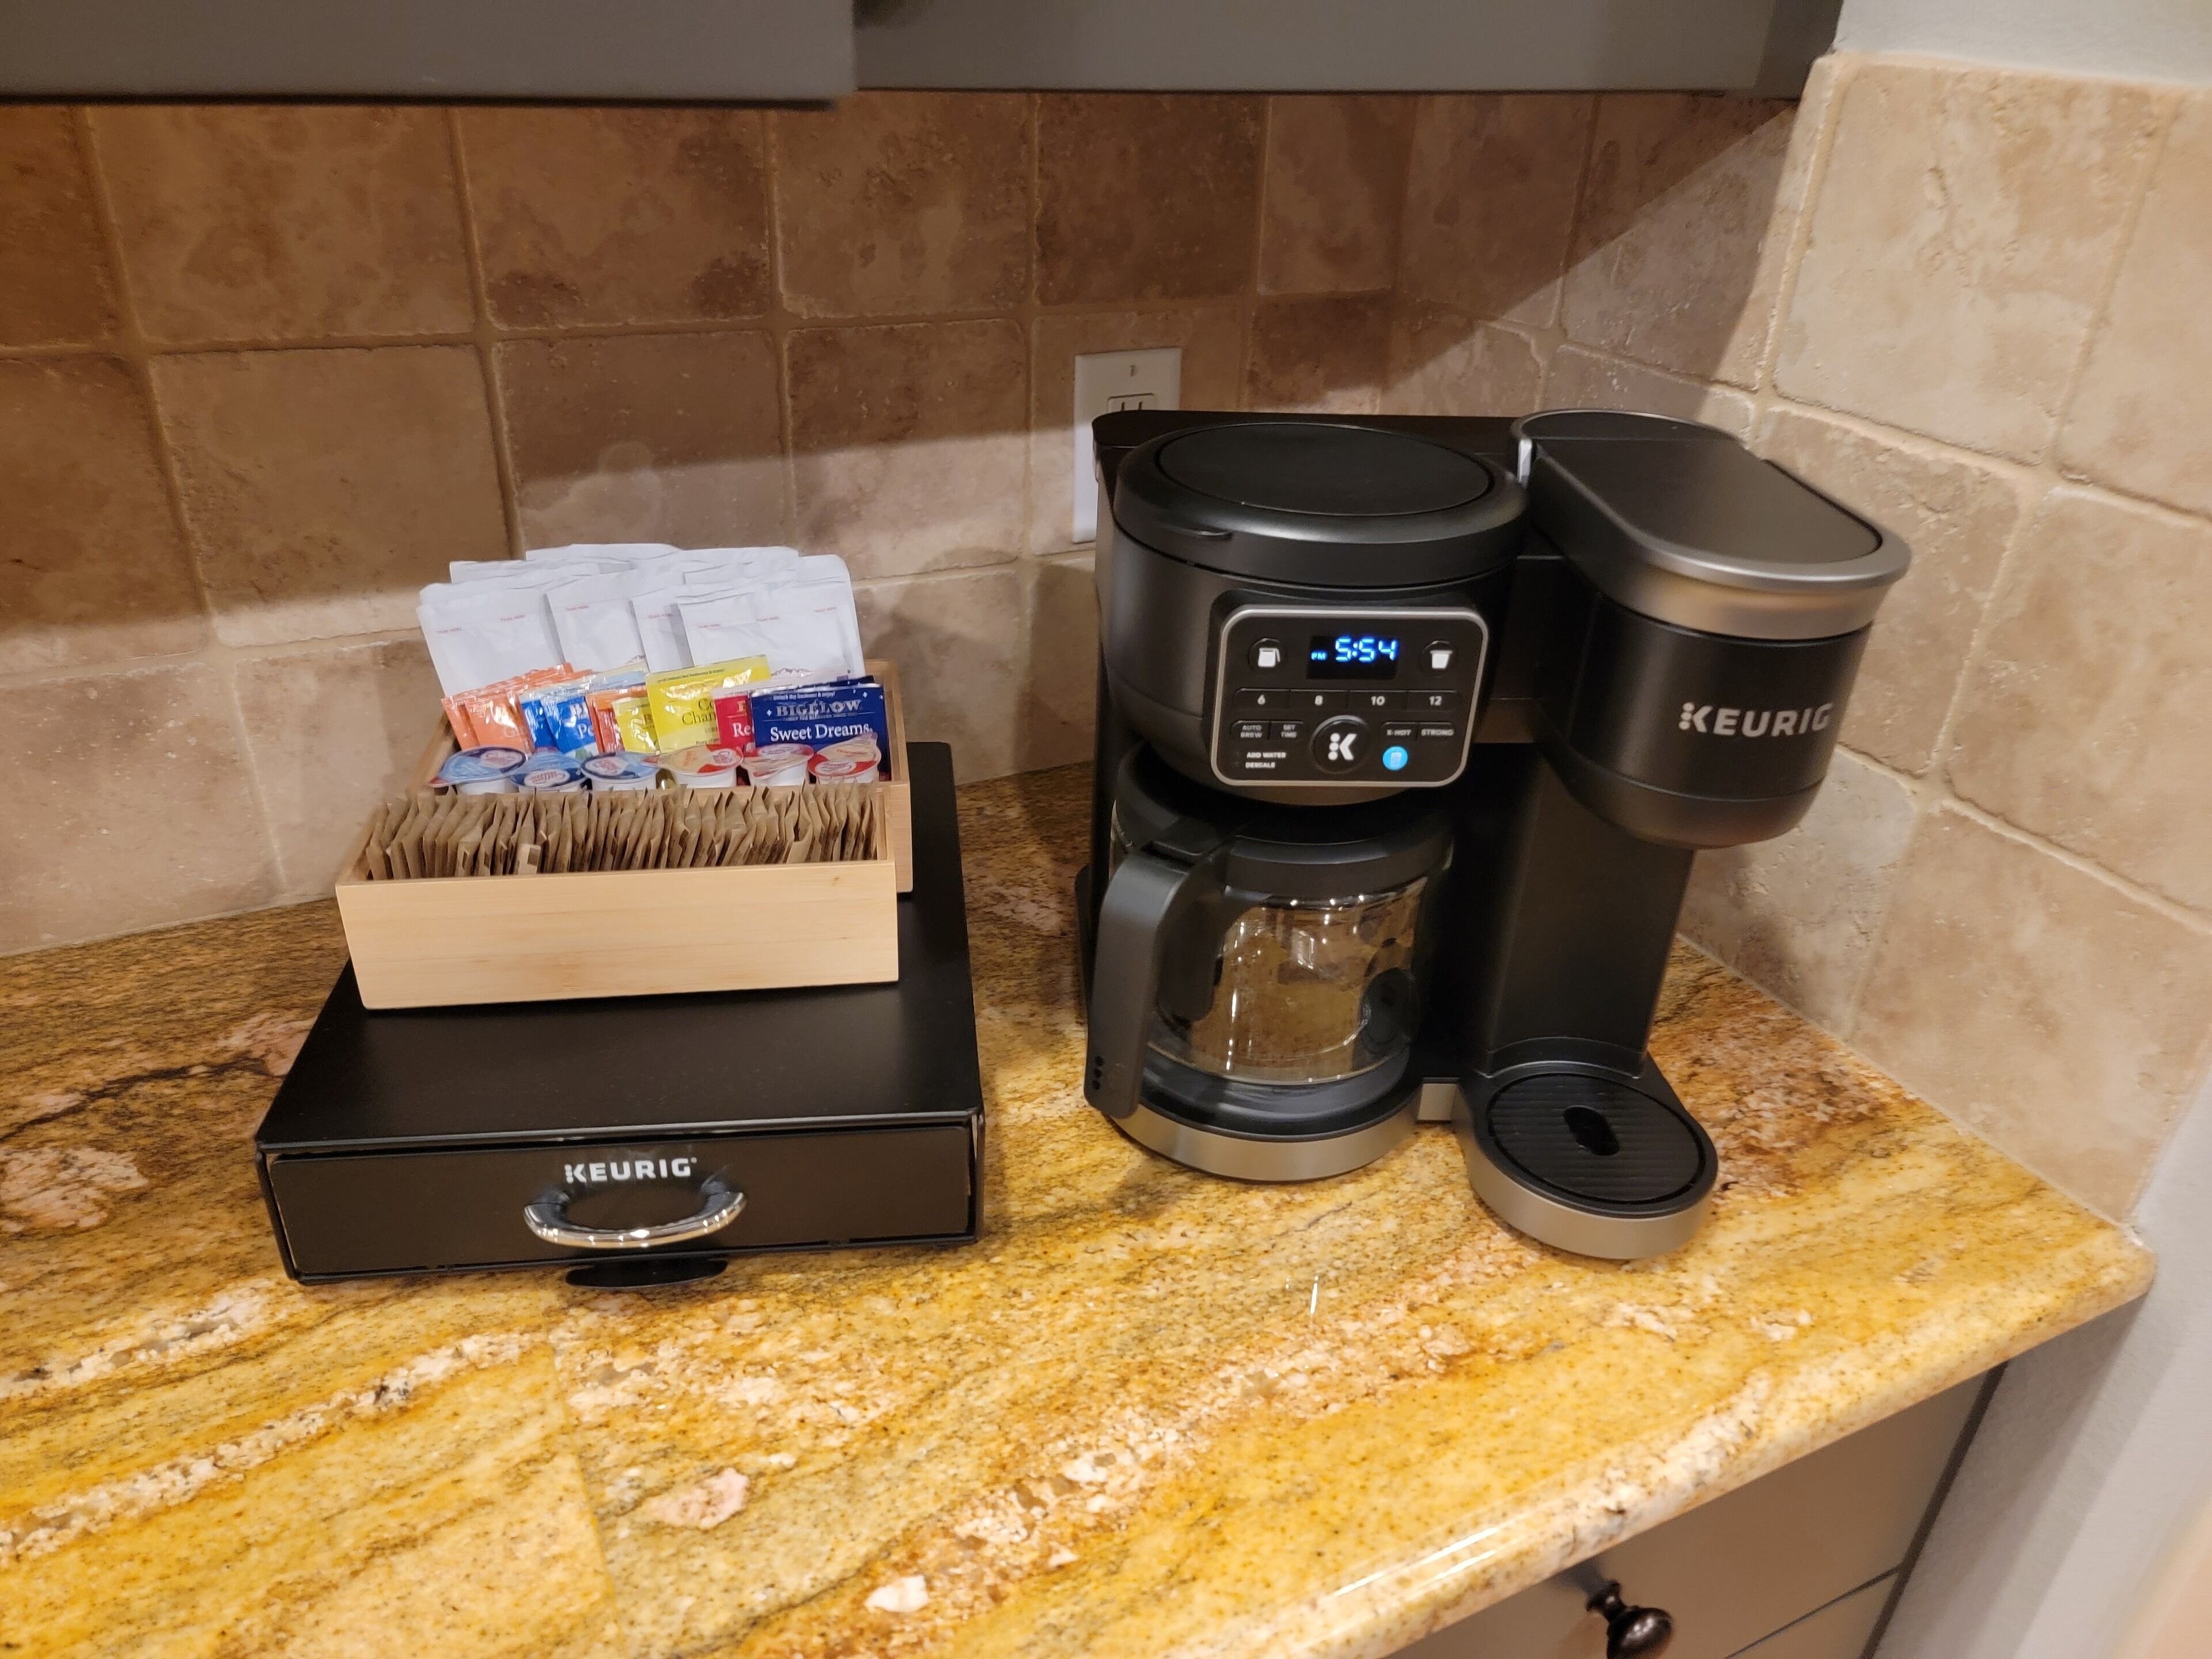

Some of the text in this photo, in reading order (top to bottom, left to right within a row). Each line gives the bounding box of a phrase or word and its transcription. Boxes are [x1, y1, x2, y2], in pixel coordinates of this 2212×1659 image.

[1311, 637, 1397, 662] PM 5:54
[775, 699, 861, 717] BIGELOW
[1257, 695, 1266, 705] 6
[1314, 695, 1324, 706] 8
[1370, 695, 1385, 706] 10
[1429, 695, 1442, 706] 12
[1677, 702, 1834, 737] KEURIG
[732, 722, 755, 738] Re
[770, 723, 869, 742] Sweet Dreams
[1421, 728, 1455, 736] STRONG
[564, 1157, 691, 1184] KEURIG
